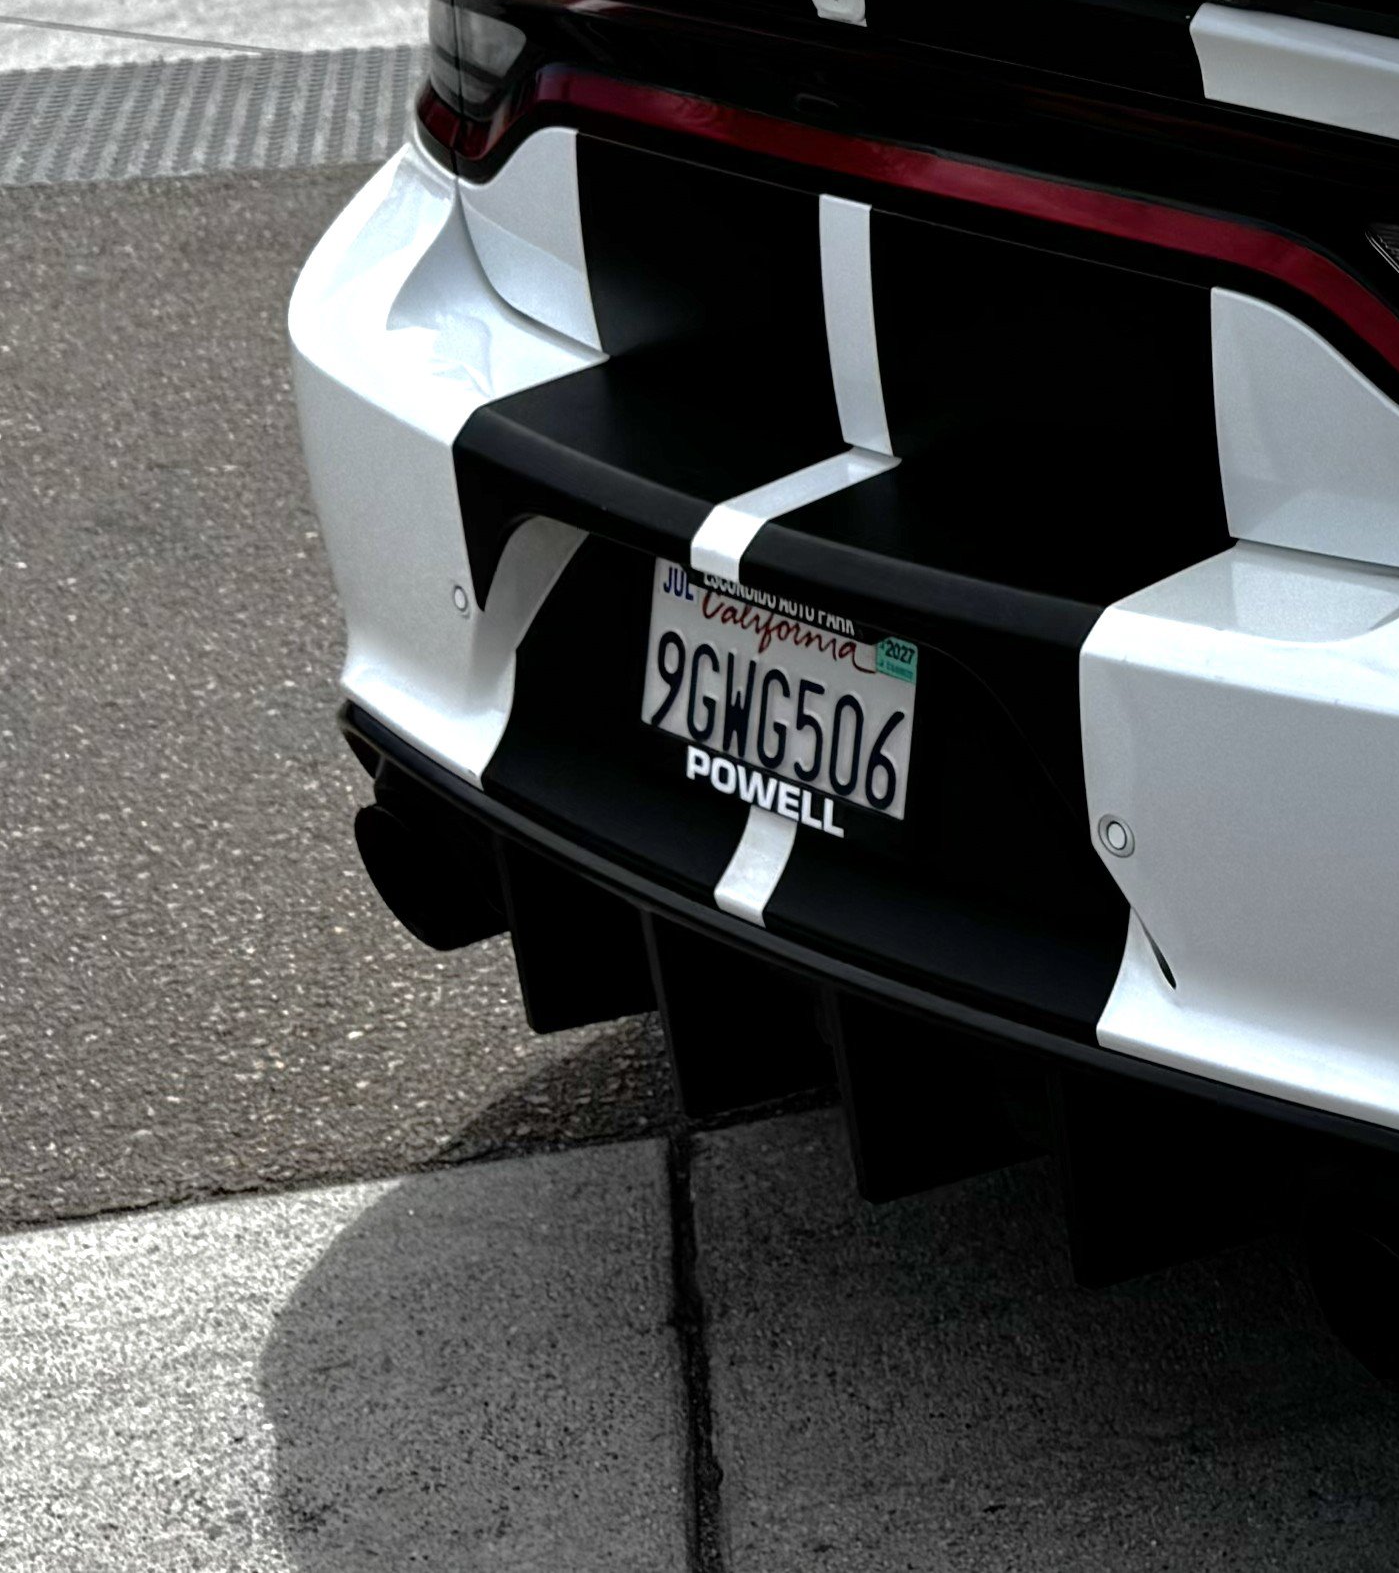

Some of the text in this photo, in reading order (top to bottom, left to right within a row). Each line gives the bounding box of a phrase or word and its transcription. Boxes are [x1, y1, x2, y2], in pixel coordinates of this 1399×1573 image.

[662, 565, 694, 601] JUL
[702, 591, 877, 674] California
[885, 639, 916, 665] 2027
[651, 630, 906, 811] 9GWG506
[686, 745, 845, 838] POWELL
